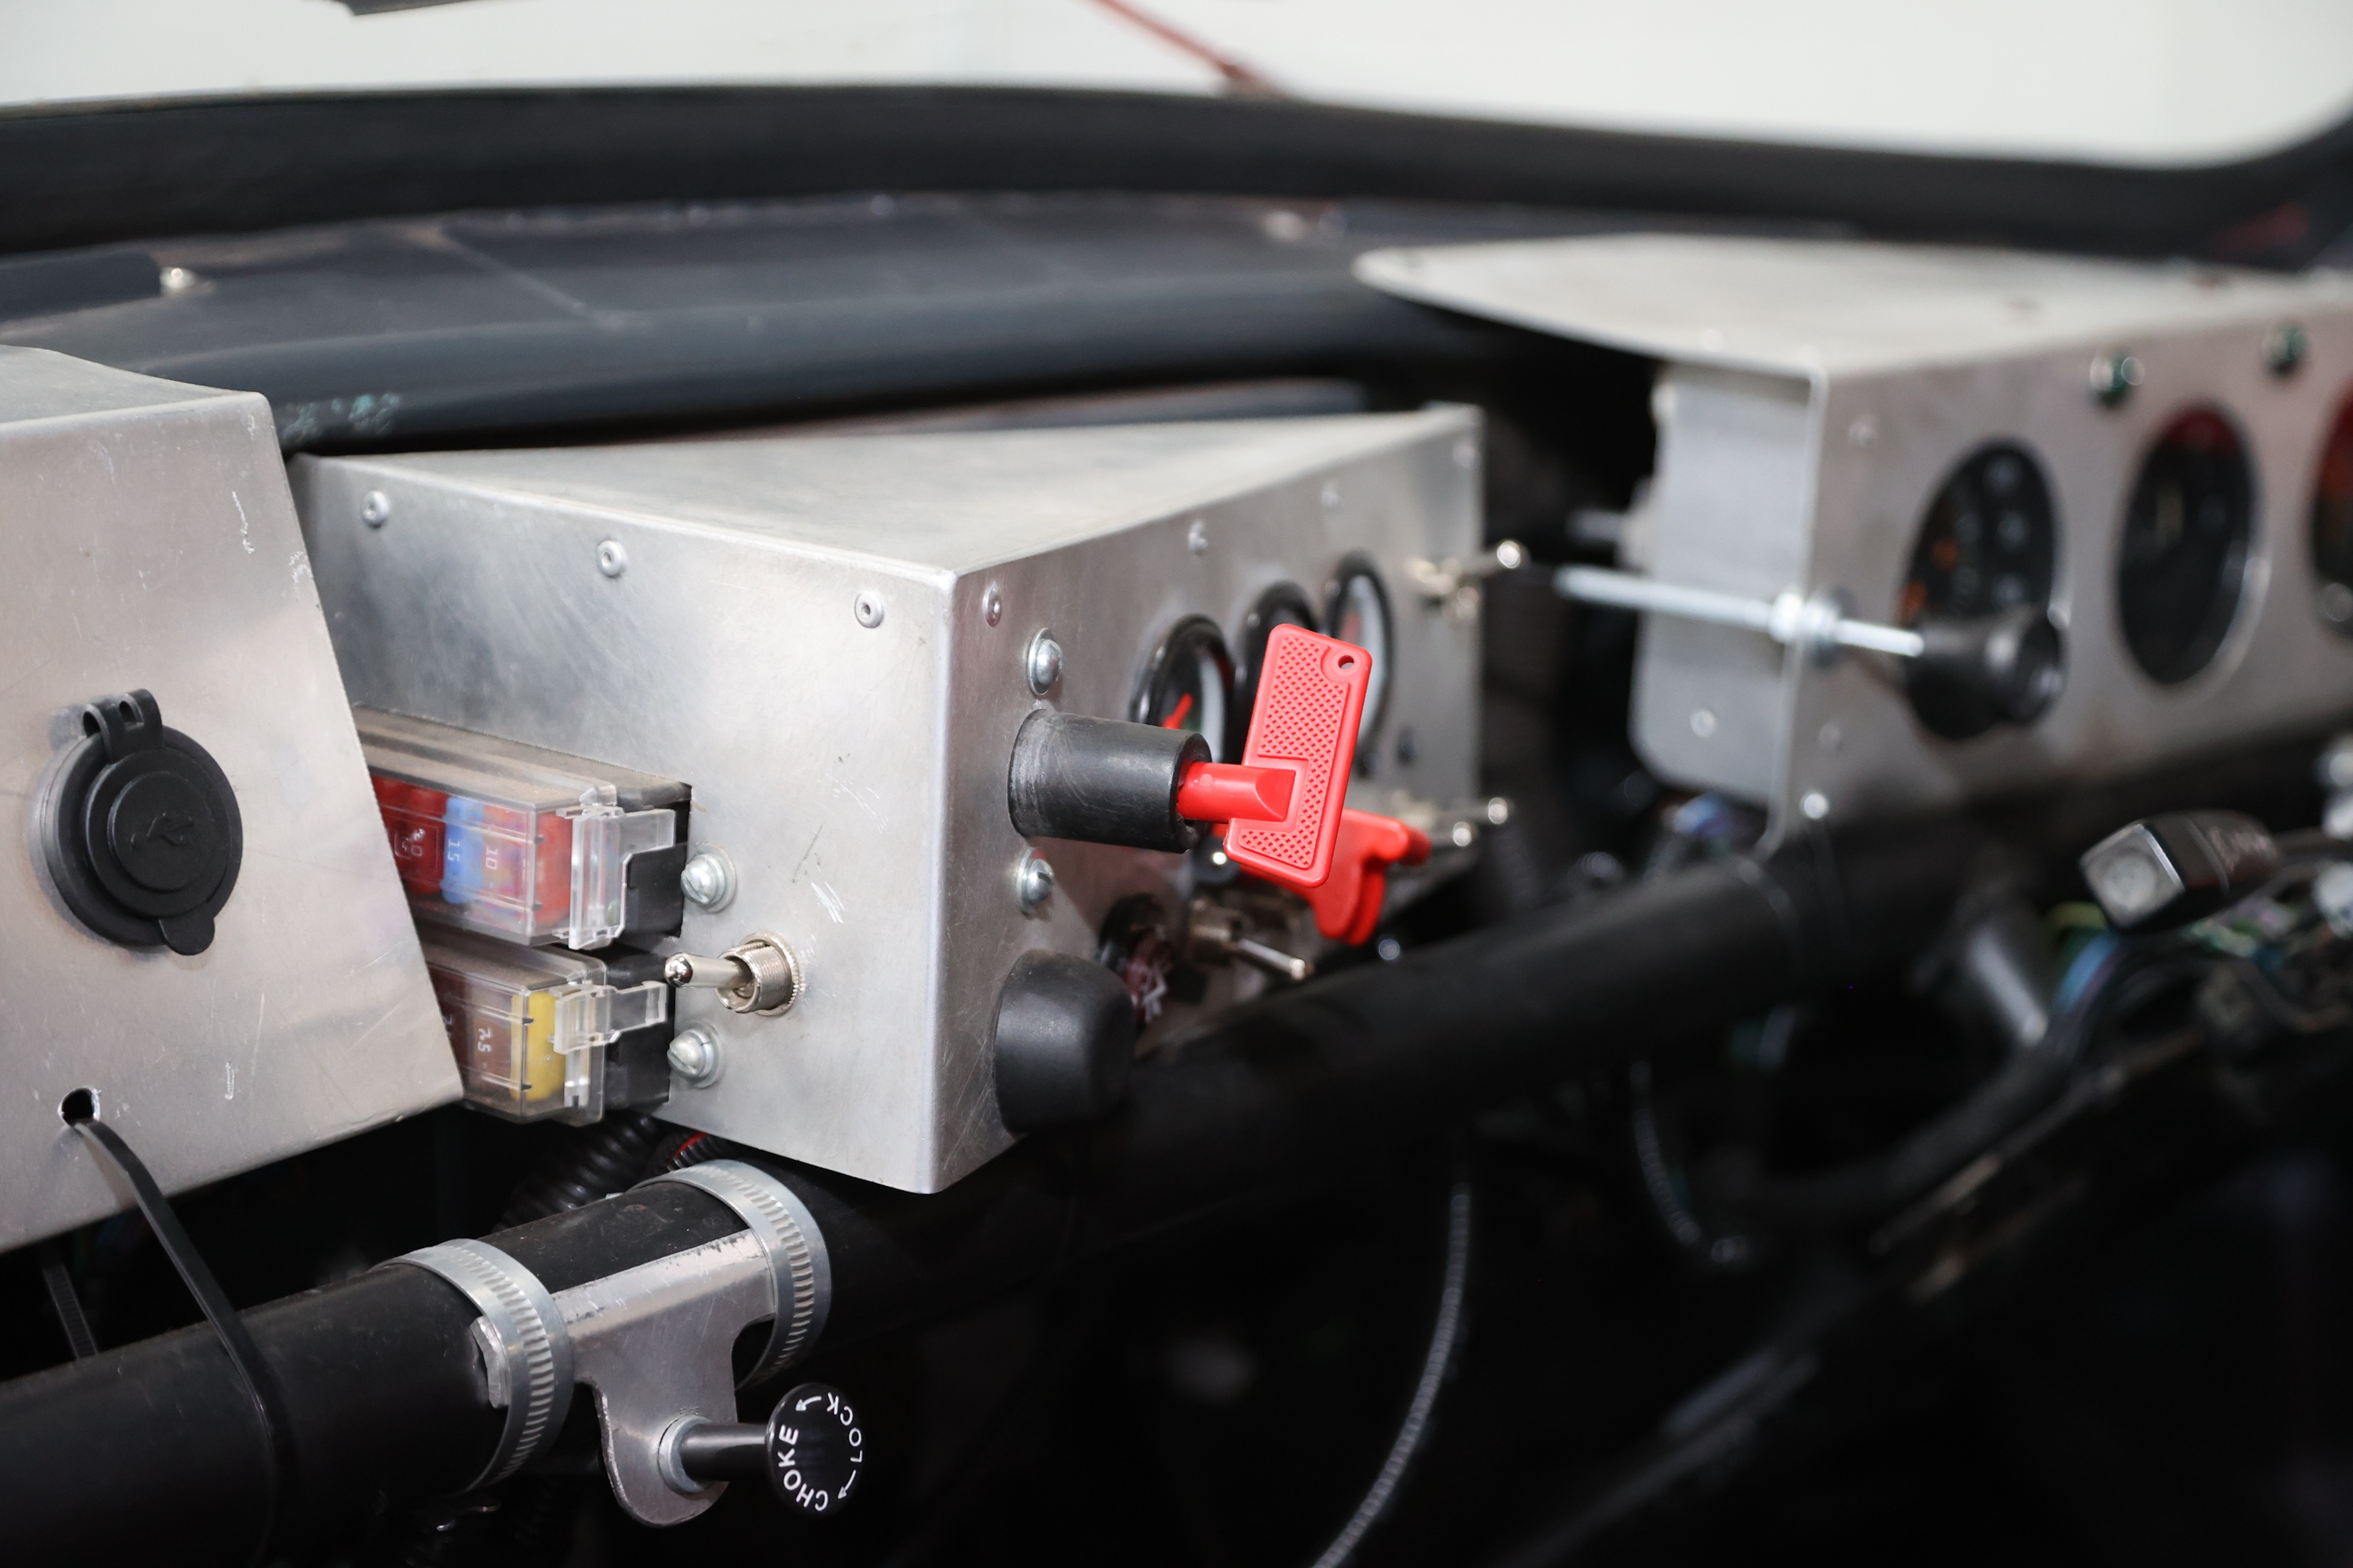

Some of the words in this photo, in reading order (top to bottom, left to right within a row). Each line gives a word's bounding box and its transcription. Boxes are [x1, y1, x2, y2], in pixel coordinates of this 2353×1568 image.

[448, 838, 460, 861] 15
[485, 847, 497, 870] 10
[826, 1392, 862, 1463] LOCK
[778, 1424, 828, 1511] CHOKE
